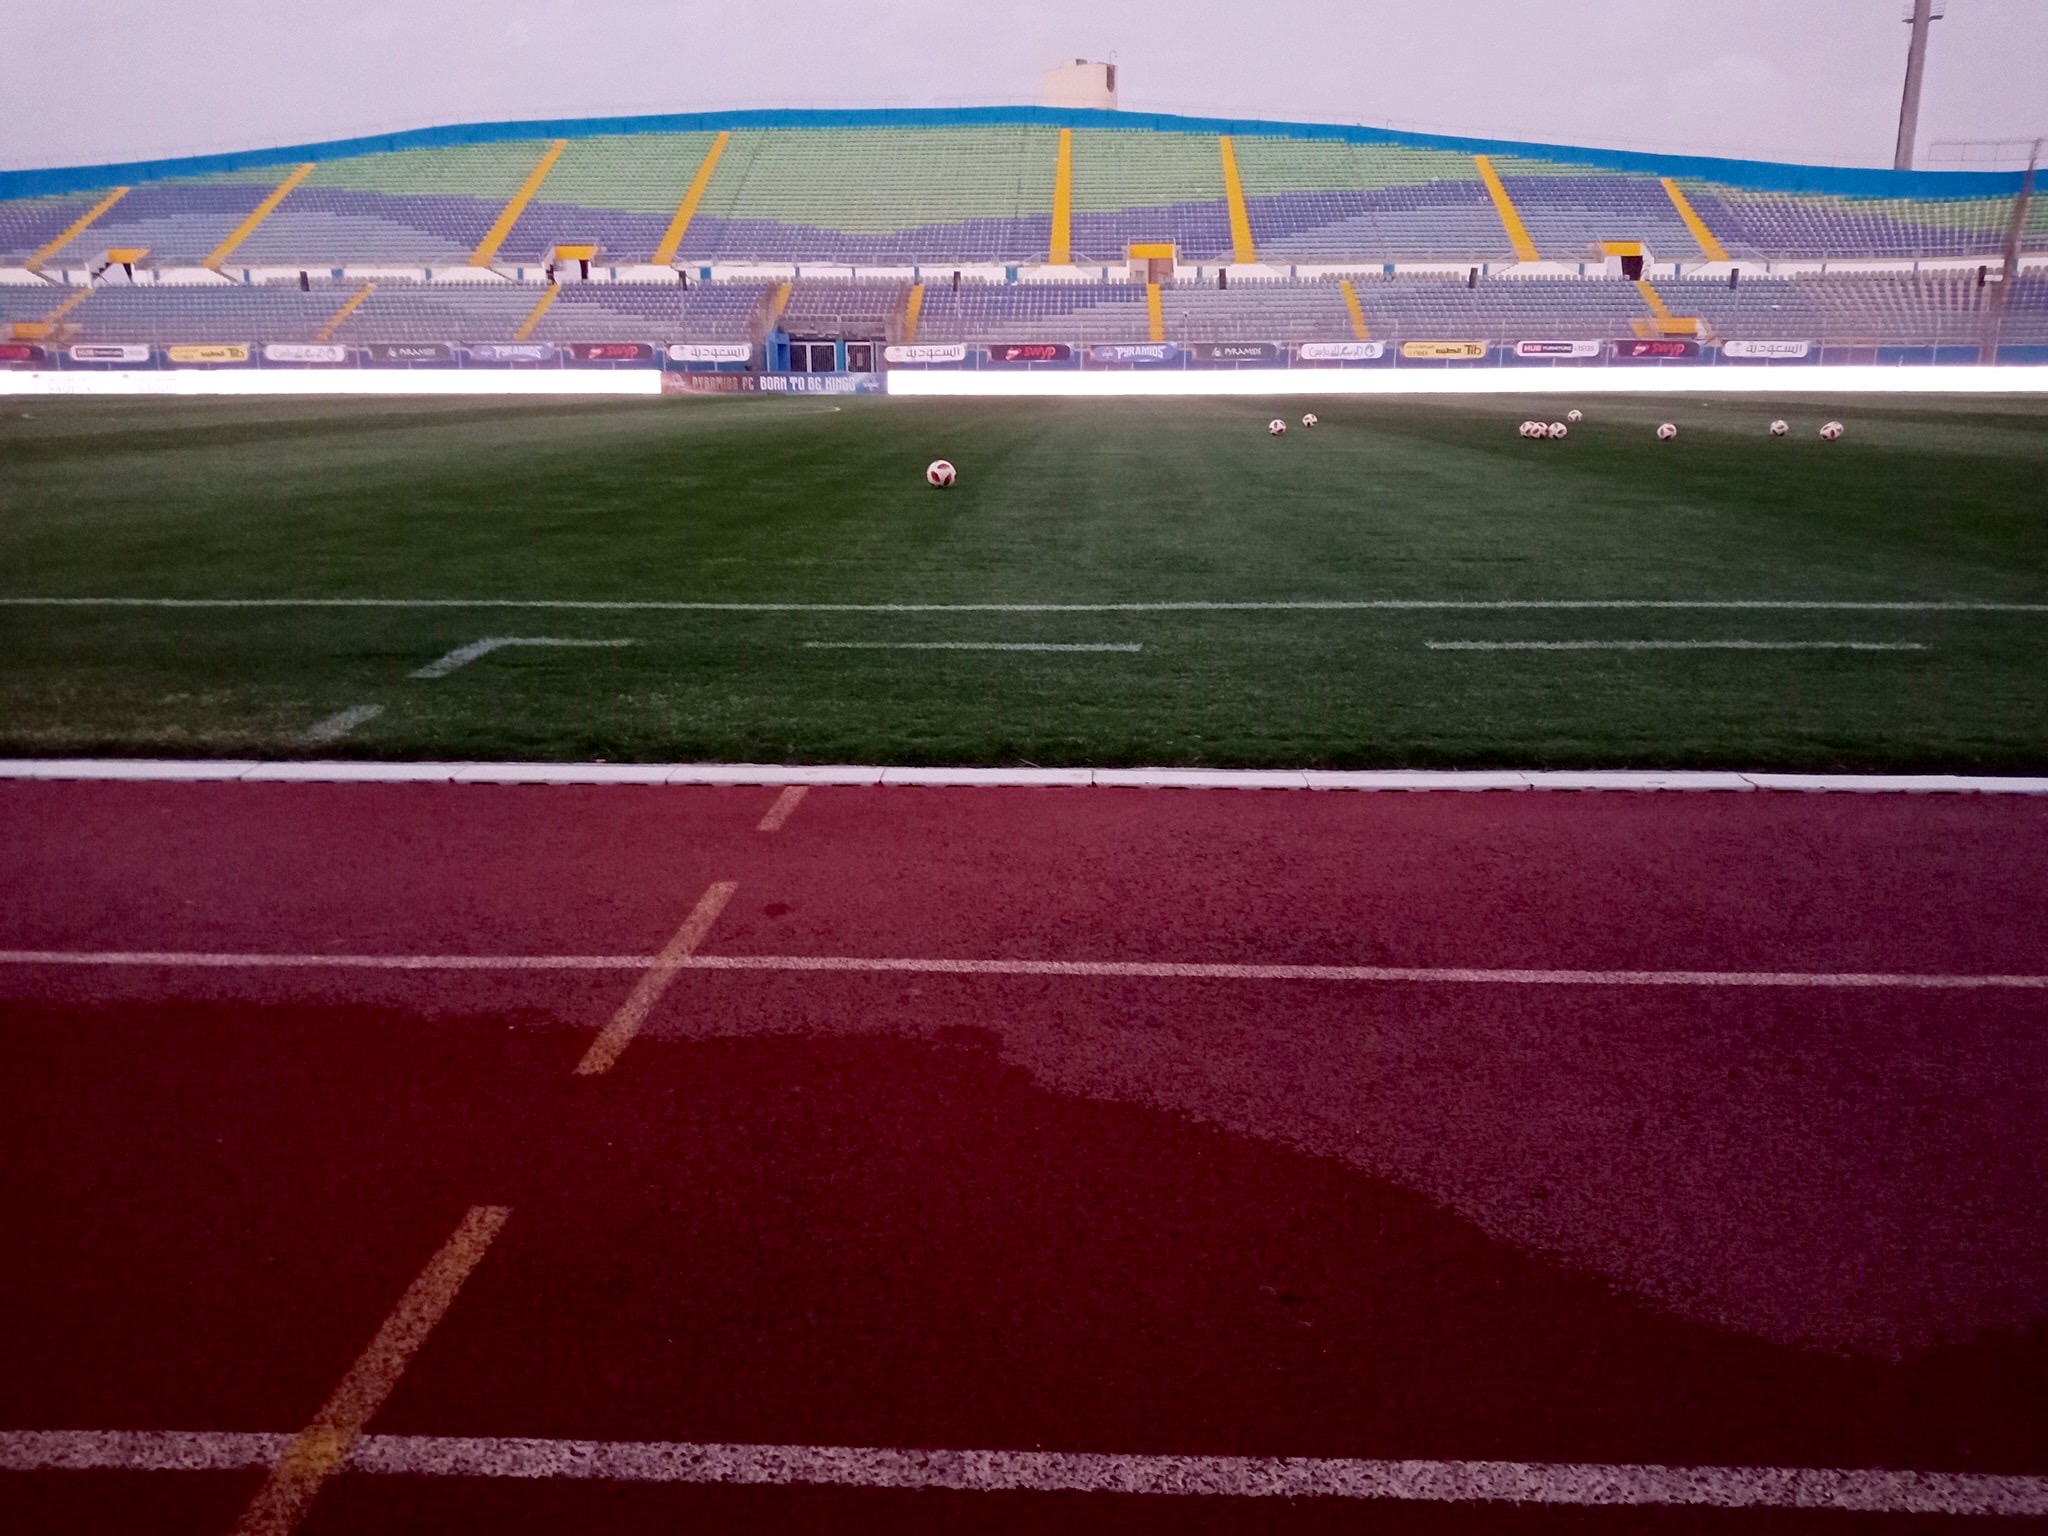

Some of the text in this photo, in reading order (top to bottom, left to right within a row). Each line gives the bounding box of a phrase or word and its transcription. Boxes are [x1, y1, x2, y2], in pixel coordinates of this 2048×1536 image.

[906, 346, 960, 359] السعودية
[1746, 343, 1802, 354] السعودية
[759, 376, 787, 390] BORN
[789, 376, 805, 390] TO
[807, 376, 821, 390] BE
[825, 376, 856, 390] KINGS
